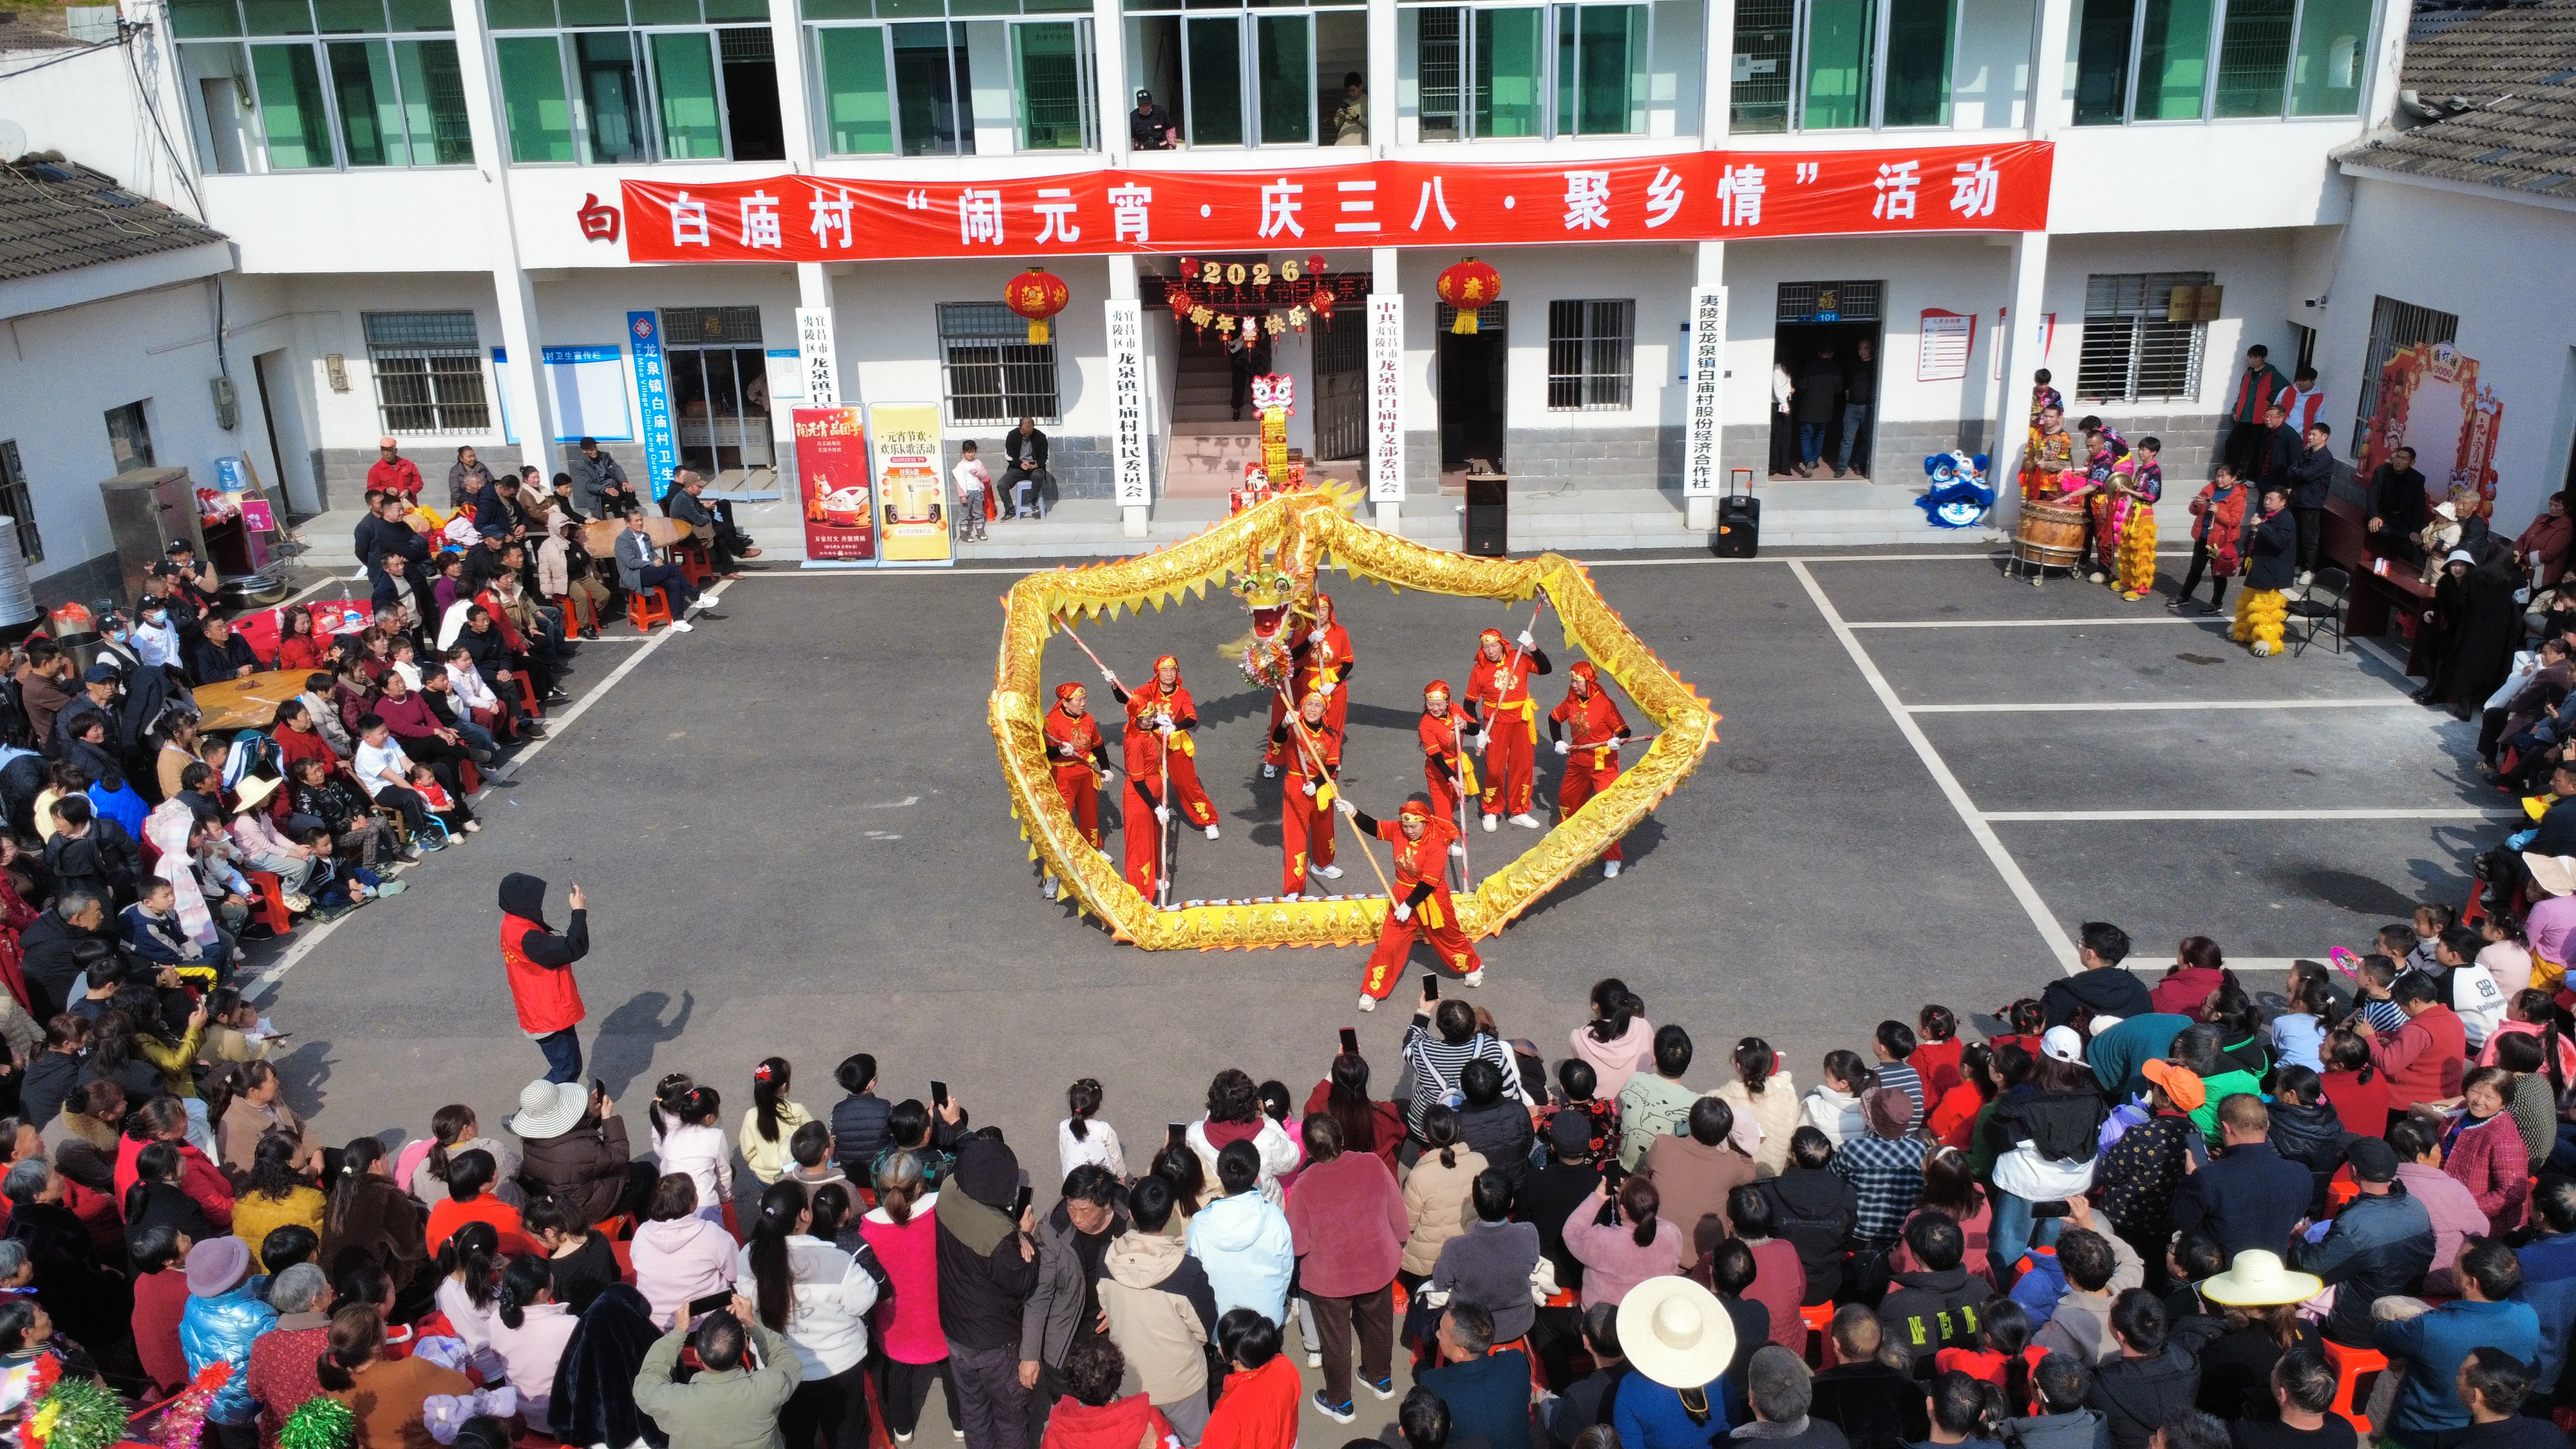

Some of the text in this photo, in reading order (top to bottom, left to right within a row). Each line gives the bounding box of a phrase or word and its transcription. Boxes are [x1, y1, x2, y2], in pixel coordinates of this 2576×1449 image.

[577, 193, 620, 242] 白
[1203, 259, 1300, 285] 2026
[1113, 310, 1123, 349] 夷陵区
[1124, 310, 1135, 349] 宜昌市
[1189, 305, 1308, 335] 新年 快乐
[1376, 302, 1397, 325] 中共
[804, 316, 816, 354] 夷陵区
[815, 316, 828, 354] 宜昌市
[1376, 326, 1385, 359] 夷陵区
[1387, 326, 1397, 359] 宜昌市
[542, 350, 601, 361] 村卫生宣传栏
[1692, 294, 1719, 489] 夷陵区龙泉镇白庙村股份经济合作社
[640, 379, 649, 407] Village
[647, 433, 656, 453] Long
[653, 476, 661, 498] Town
[643, 343, 674, 496] 龙泉镇白庙村卫生
[795, 420, 862, 438] 闹元宵 品团子
[887, 431, 926, 443] 元宵节欢
[1117, 352, 1142, 498] 龙泉镇白庙村村民委员会
[1377, 360, 1398, 493] 龙泉镇白庙村支部委员会
